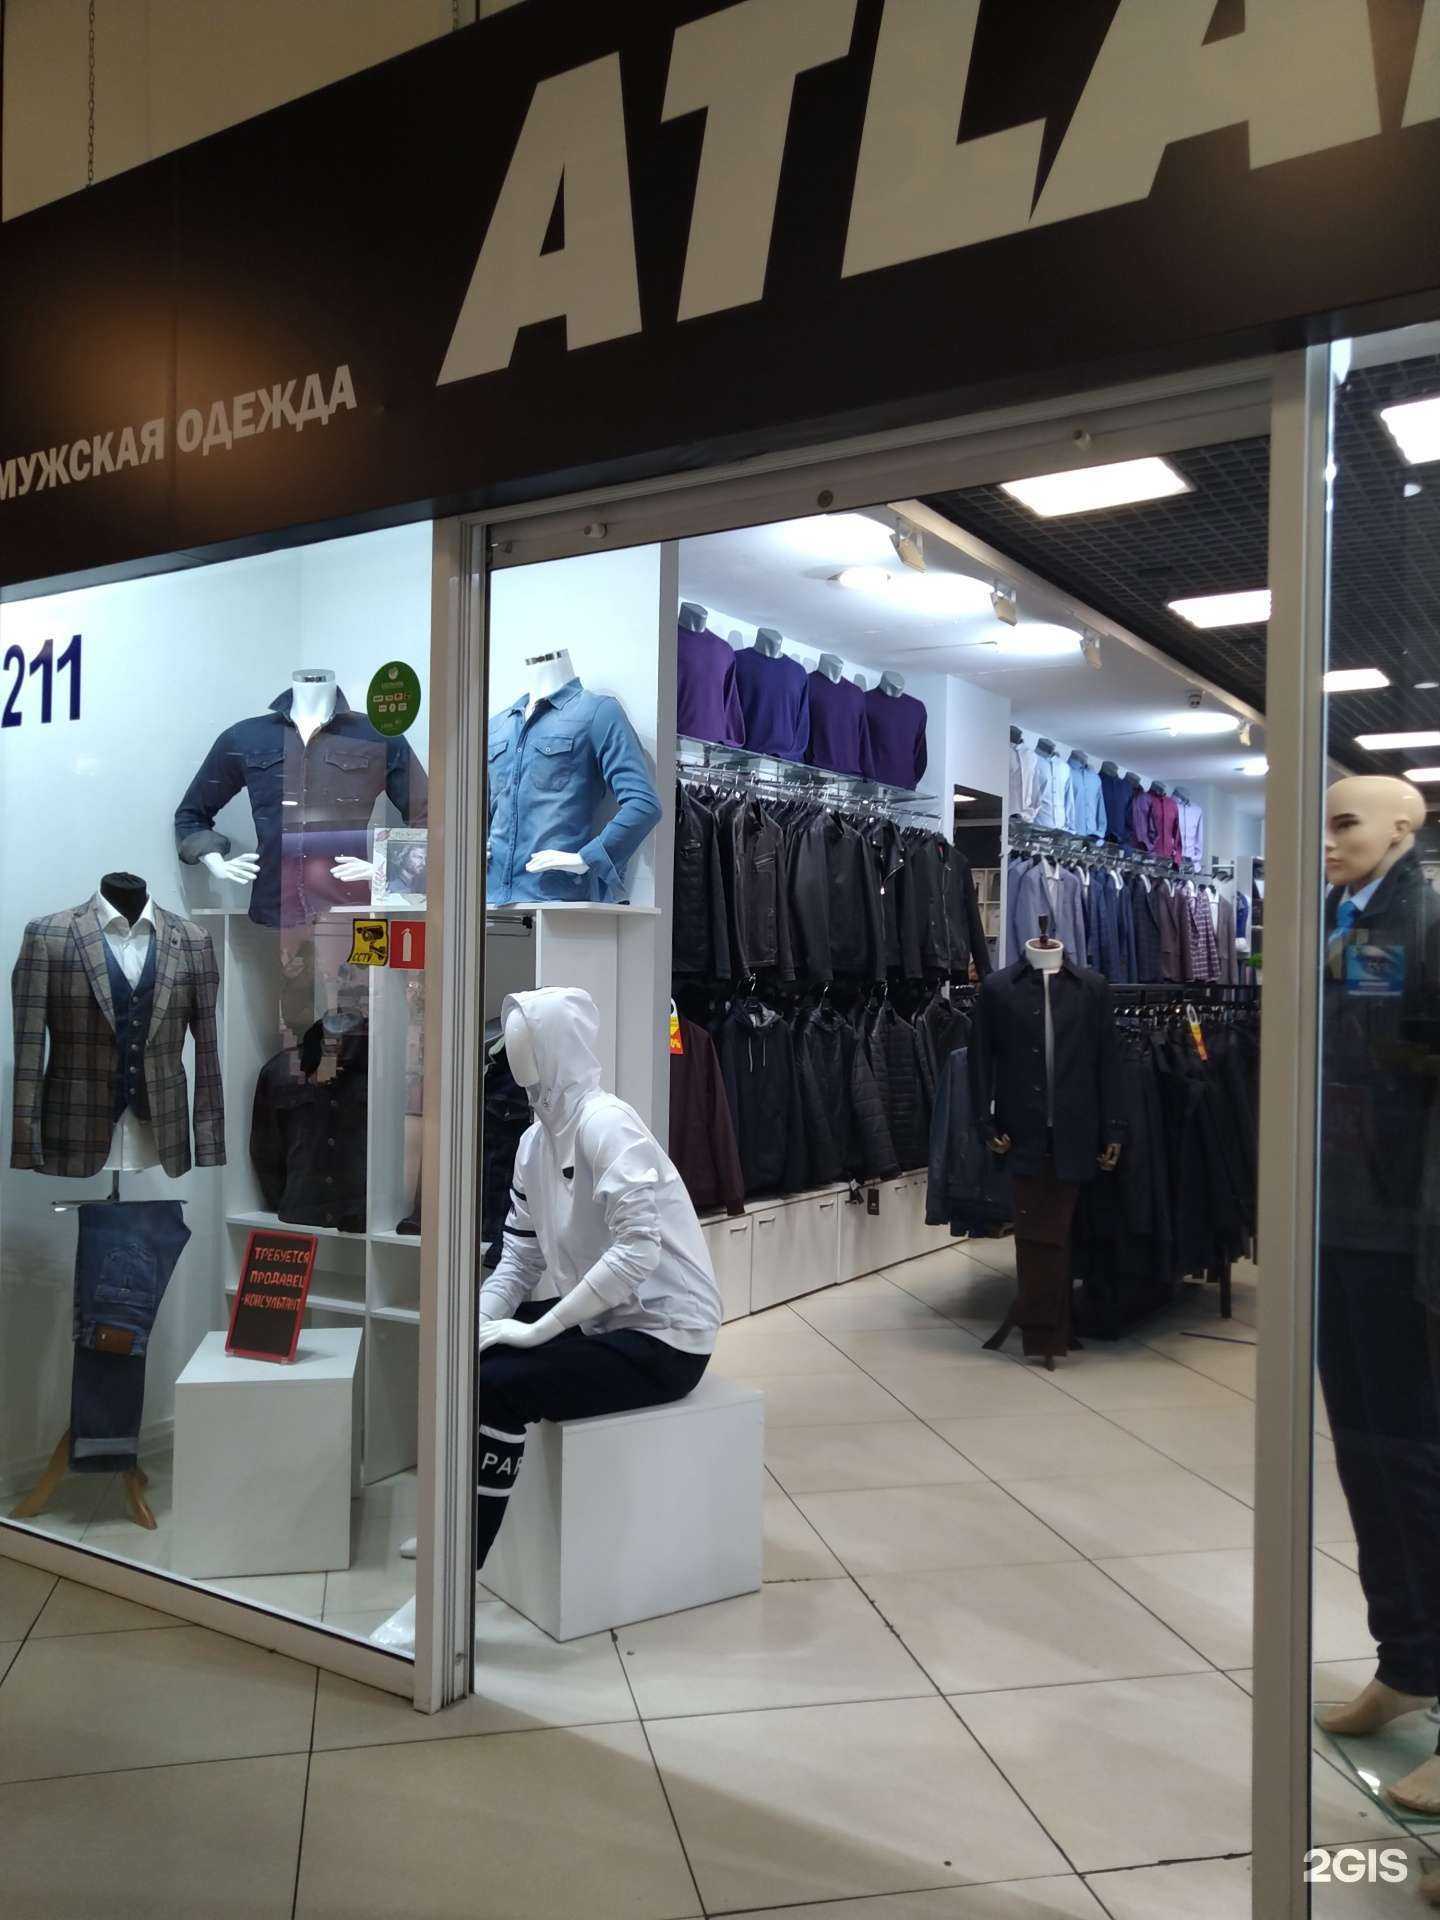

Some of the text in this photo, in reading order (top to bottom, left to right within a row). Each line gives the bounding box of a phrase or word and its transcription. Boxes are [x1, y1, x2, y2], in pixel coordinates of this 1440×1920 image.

[437, 0, 1440, 387] ATLA
[0, 364, 358, 500] МУЖСКАЯ ОДЕЖДА
[1, 634, 82, 728] 211
[352, 952, 372, 963] CCTV
[254, 1247, 311, 1264] ТРЕБУЕТСЯ
